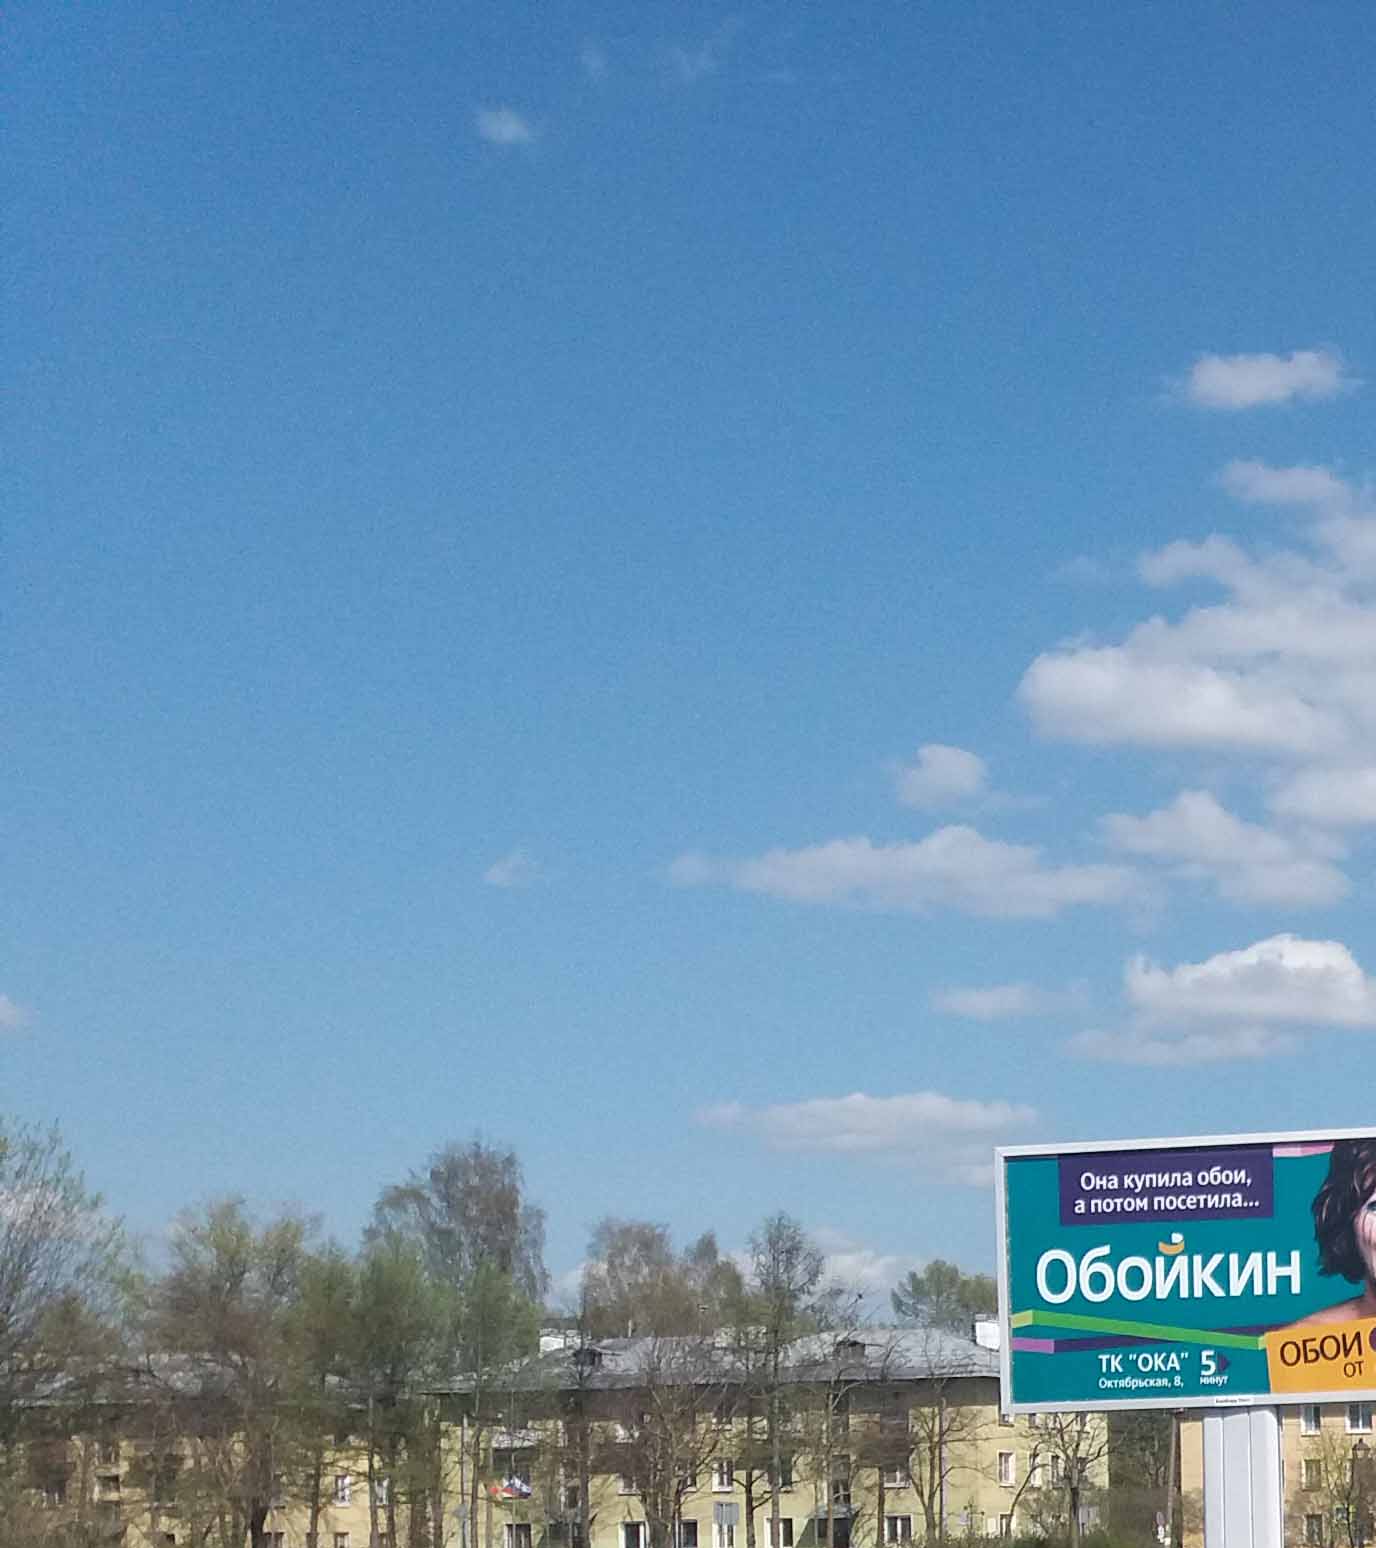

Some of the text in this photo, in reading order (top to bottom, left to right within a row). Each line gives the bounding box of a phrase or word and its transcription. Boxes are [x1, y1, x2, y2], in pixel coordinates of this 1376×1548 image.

[1080, 1166, 1252, 1192] Она купила обои,
[1074, 1192, 1260, 1214] а потом посетила...
[1280, 1331, 1363, 1367] ОБОИ
[1098, 1352, 1189, 1373] ТК "ОКА"
[1200, 1350, 1216, 1376] 5
[1098, 1376, 1171, 1390] Октябрьская,
[1200, 1375, 1229, 1387] минут
